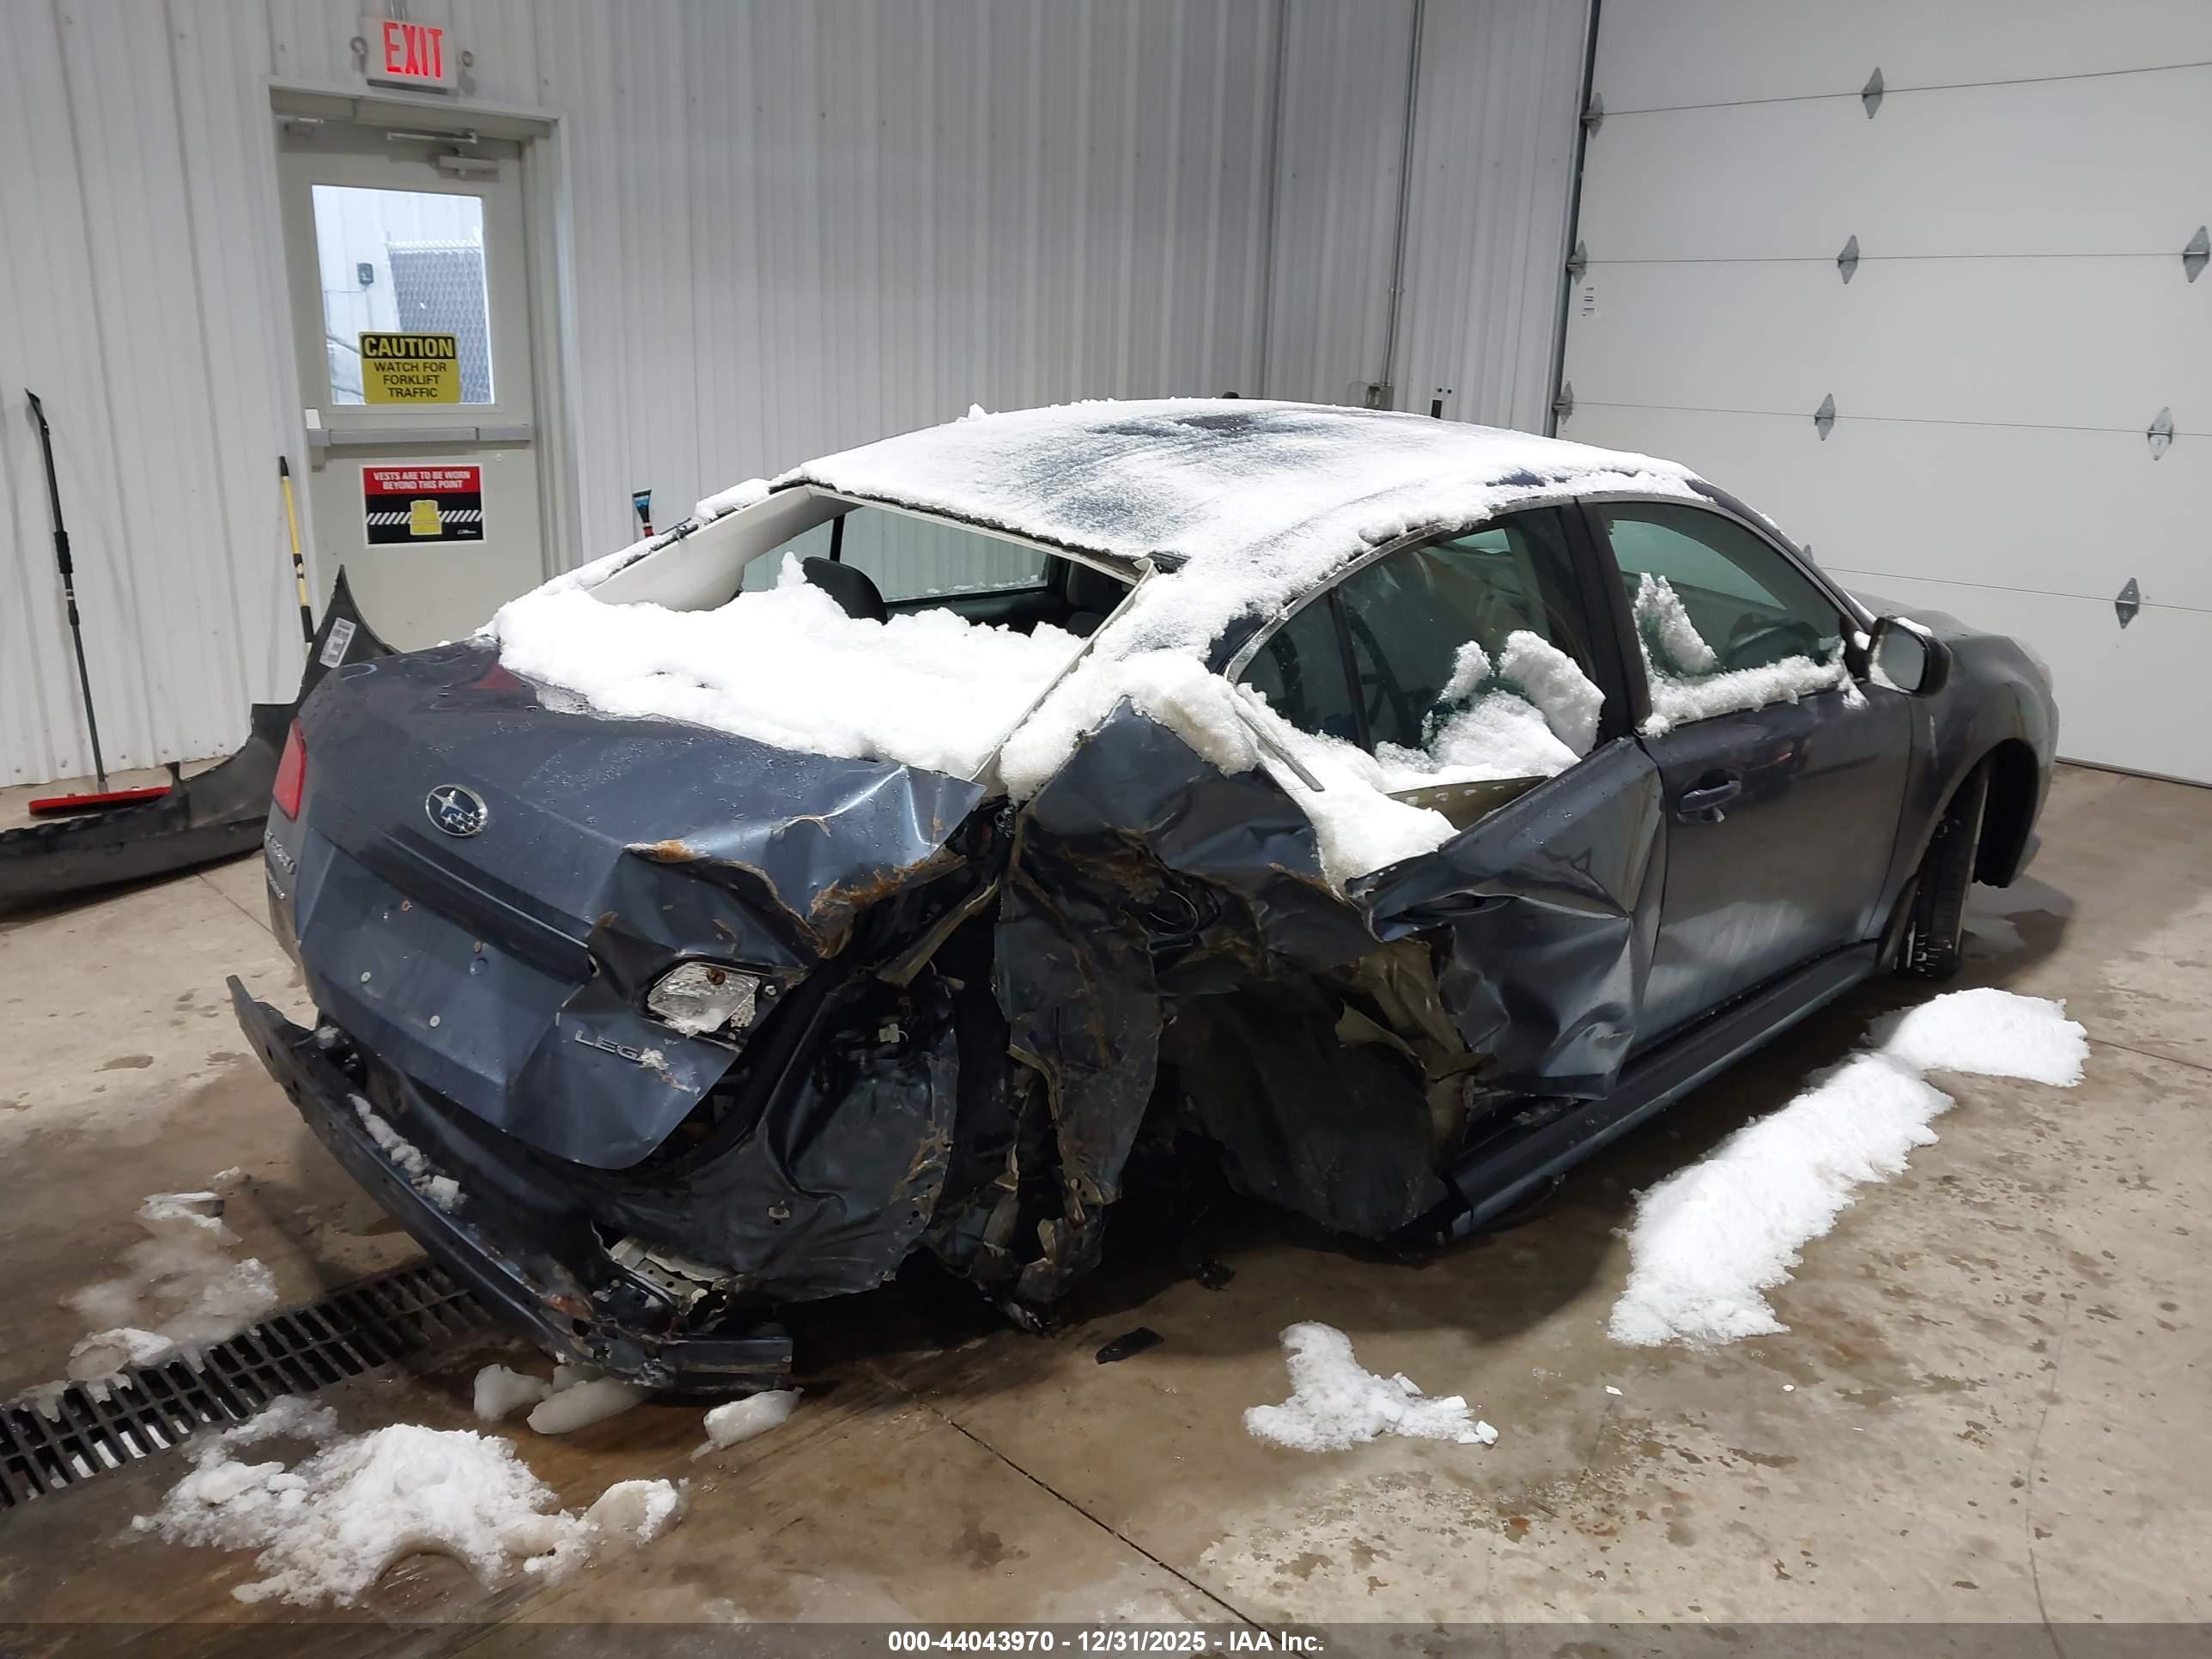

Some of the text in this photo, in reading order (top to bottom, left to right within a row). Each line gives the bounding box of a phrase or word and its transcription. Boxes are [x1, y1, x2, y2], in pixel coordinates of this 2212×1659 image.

[383, 21, 443, 78] EXIT
[363, 337, 454, 357] CAUTION
[373, 362, 447, 372] WATCH FOR
[383, 374, 441, 385] FORKLIFT
[387, 387, 438, 398] TRAFFIC
[373, 471, 400, 481] VESTS
[402, 471, 418, 480] ARE
[419, 471, 431, 480] TO
[445, 471, 471, 479] WORN
[383, 481, 417, 489] BEYOND
[439, 480, 463, 489] POINT
